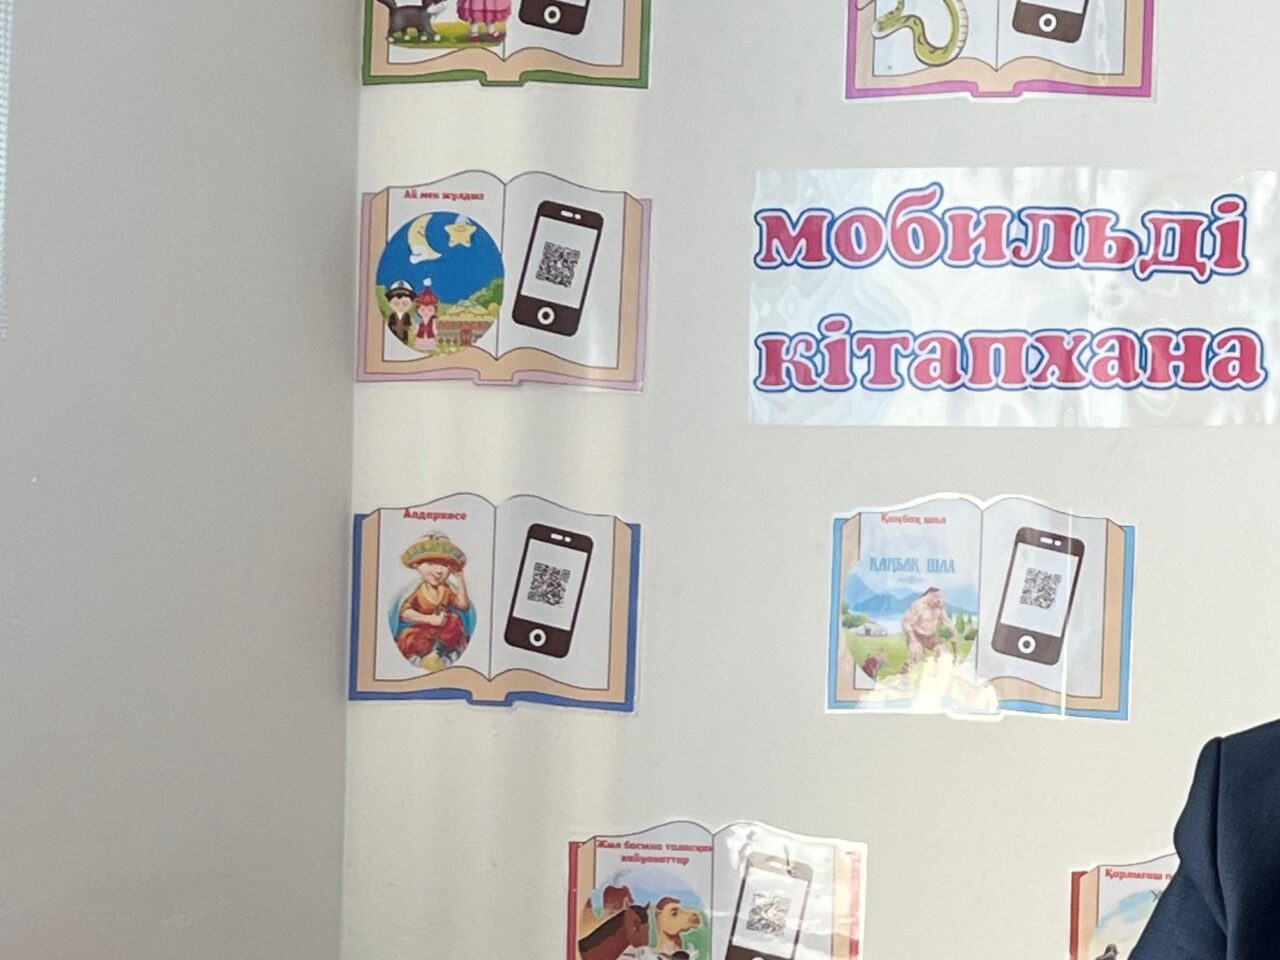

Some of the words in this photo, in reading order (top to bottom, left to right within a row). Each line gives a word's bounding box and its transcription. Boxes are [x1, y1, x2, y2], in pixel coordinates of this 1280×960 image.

[404, 189, 417, 199] Ай
[754, 182, 1249, 283] мобильді
[754, 314, 1269, 392] кітапхана
[927, 558, 955, 573] ШАЛ
